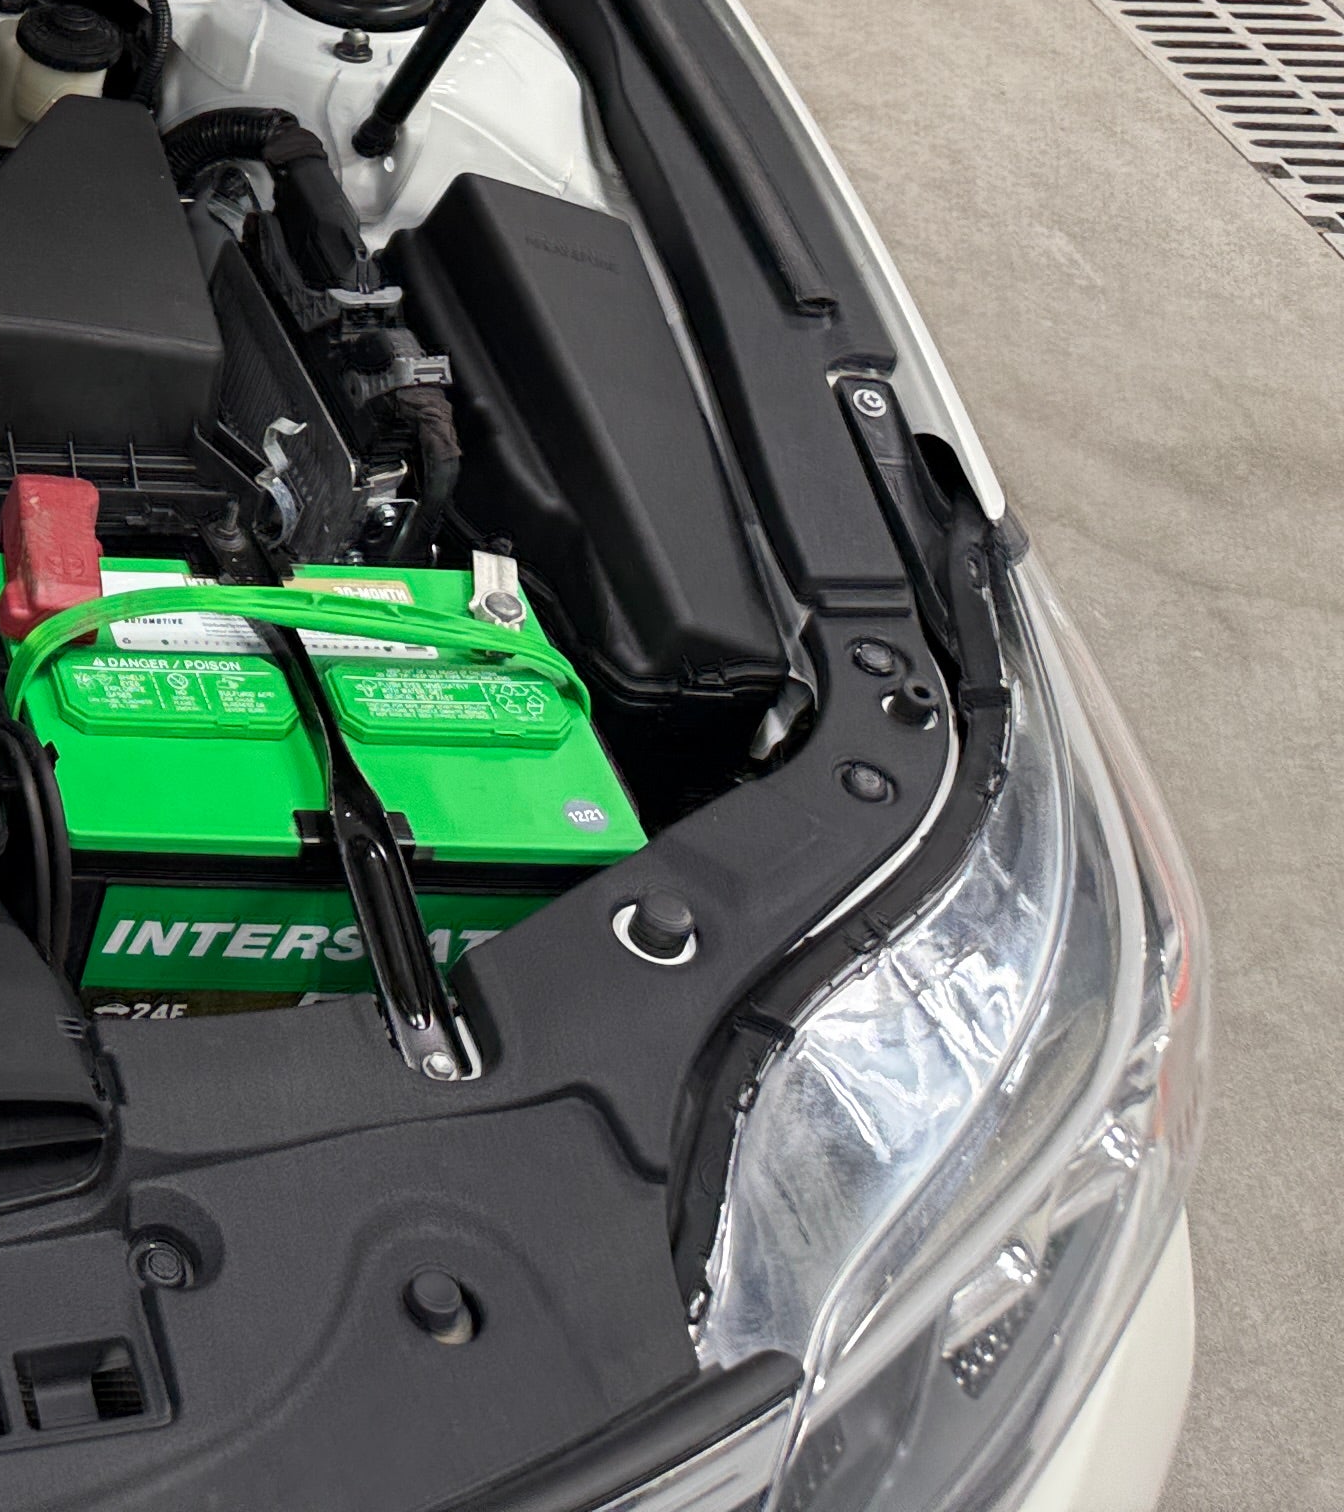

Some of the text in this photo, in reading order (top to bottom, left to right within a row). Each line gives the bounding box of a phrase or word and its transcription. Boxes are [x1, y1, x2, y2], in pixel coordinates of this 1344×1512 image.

[107, 657, 242, 671] DANGER / POISON
[567, 808, 605, 823] 12/21
[102, 919, 503, 963] INTERSAT
[130, 1003, 188, 1020] 24F
